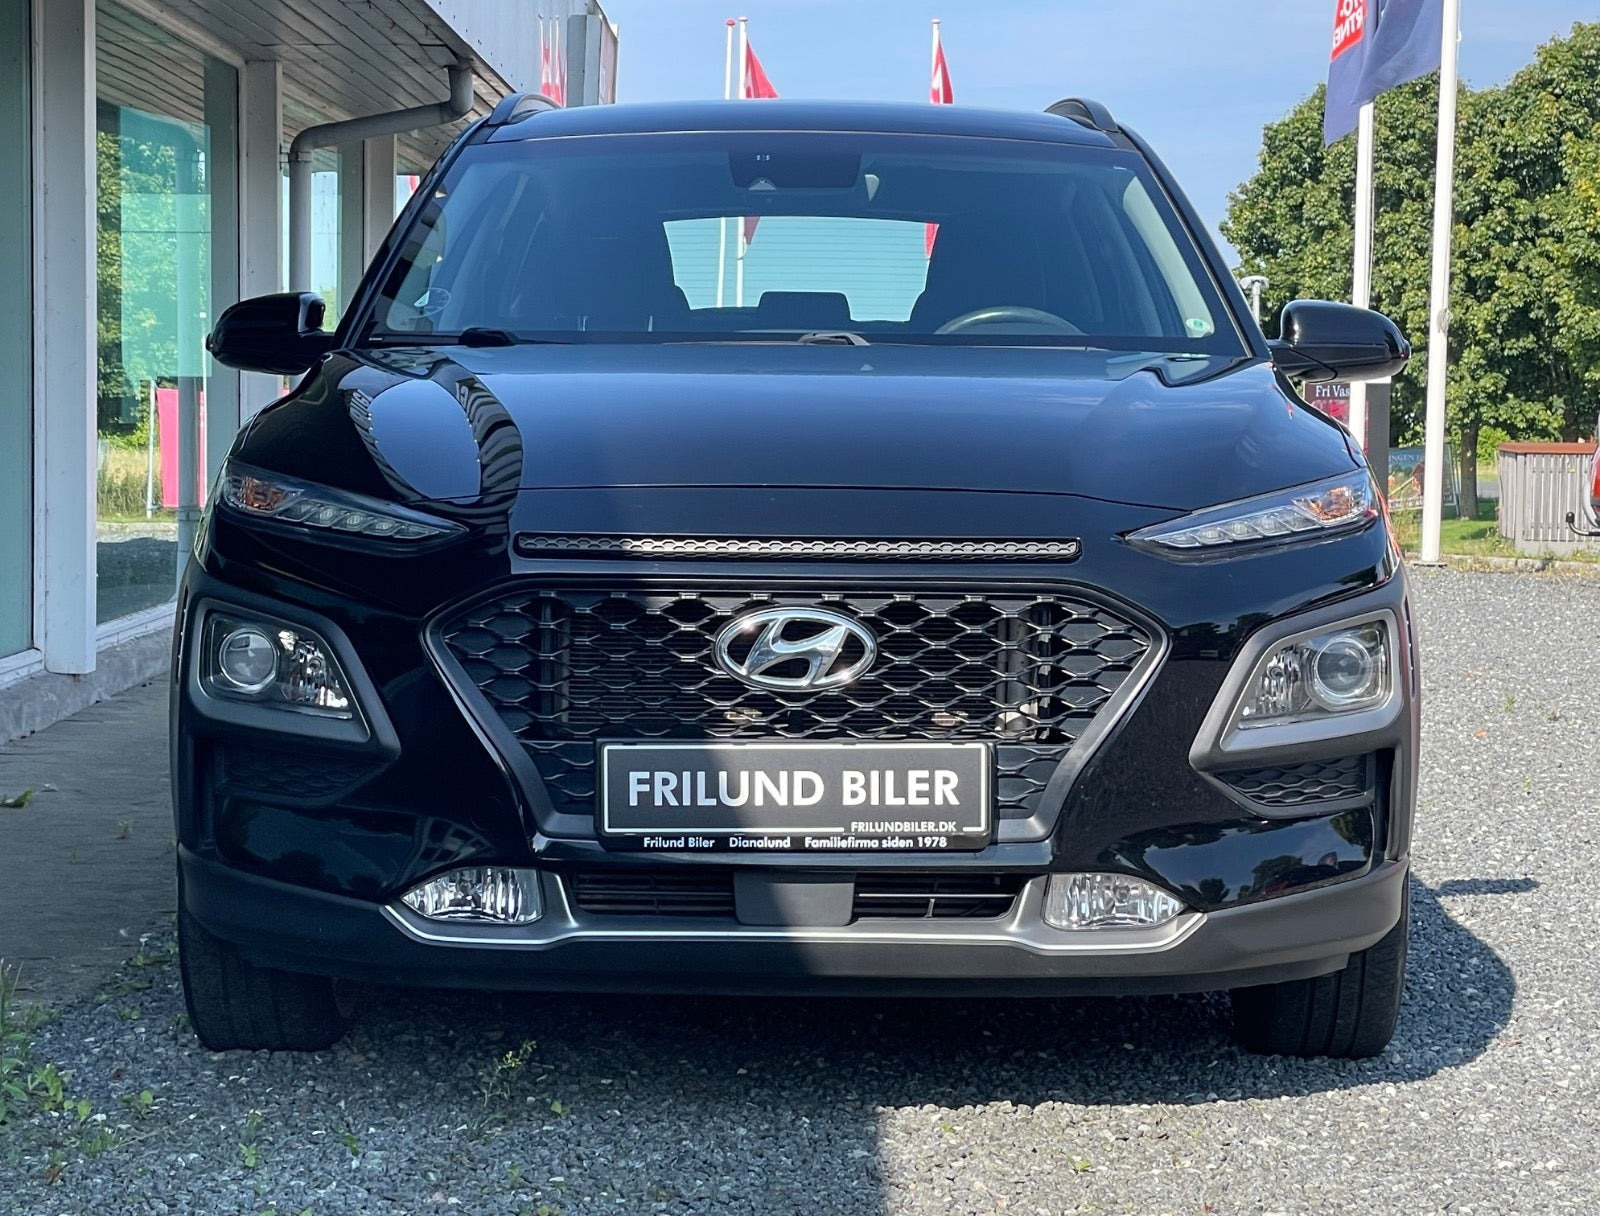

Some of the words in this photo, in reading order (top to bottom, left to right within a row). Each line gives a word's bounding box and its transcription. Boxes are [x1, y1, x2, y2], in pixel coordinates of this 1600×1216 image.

[1315, 385, 1330, 397] Fri
[629, 771, 825, 806] FRILUND
[842, 770, 960, 806] BILER
[851, 821, 957, 833] FRILUNDBILER.DK
[643, 837, 685, 848] Frilund
[688, 837, 715, 848] Biler
[729, 837, 791, 848] Dianalund
[804, 836, 879, 848] Familiefirma
[881, 836, 914, 848] siden
[917, 836, 947, 848] 1978
